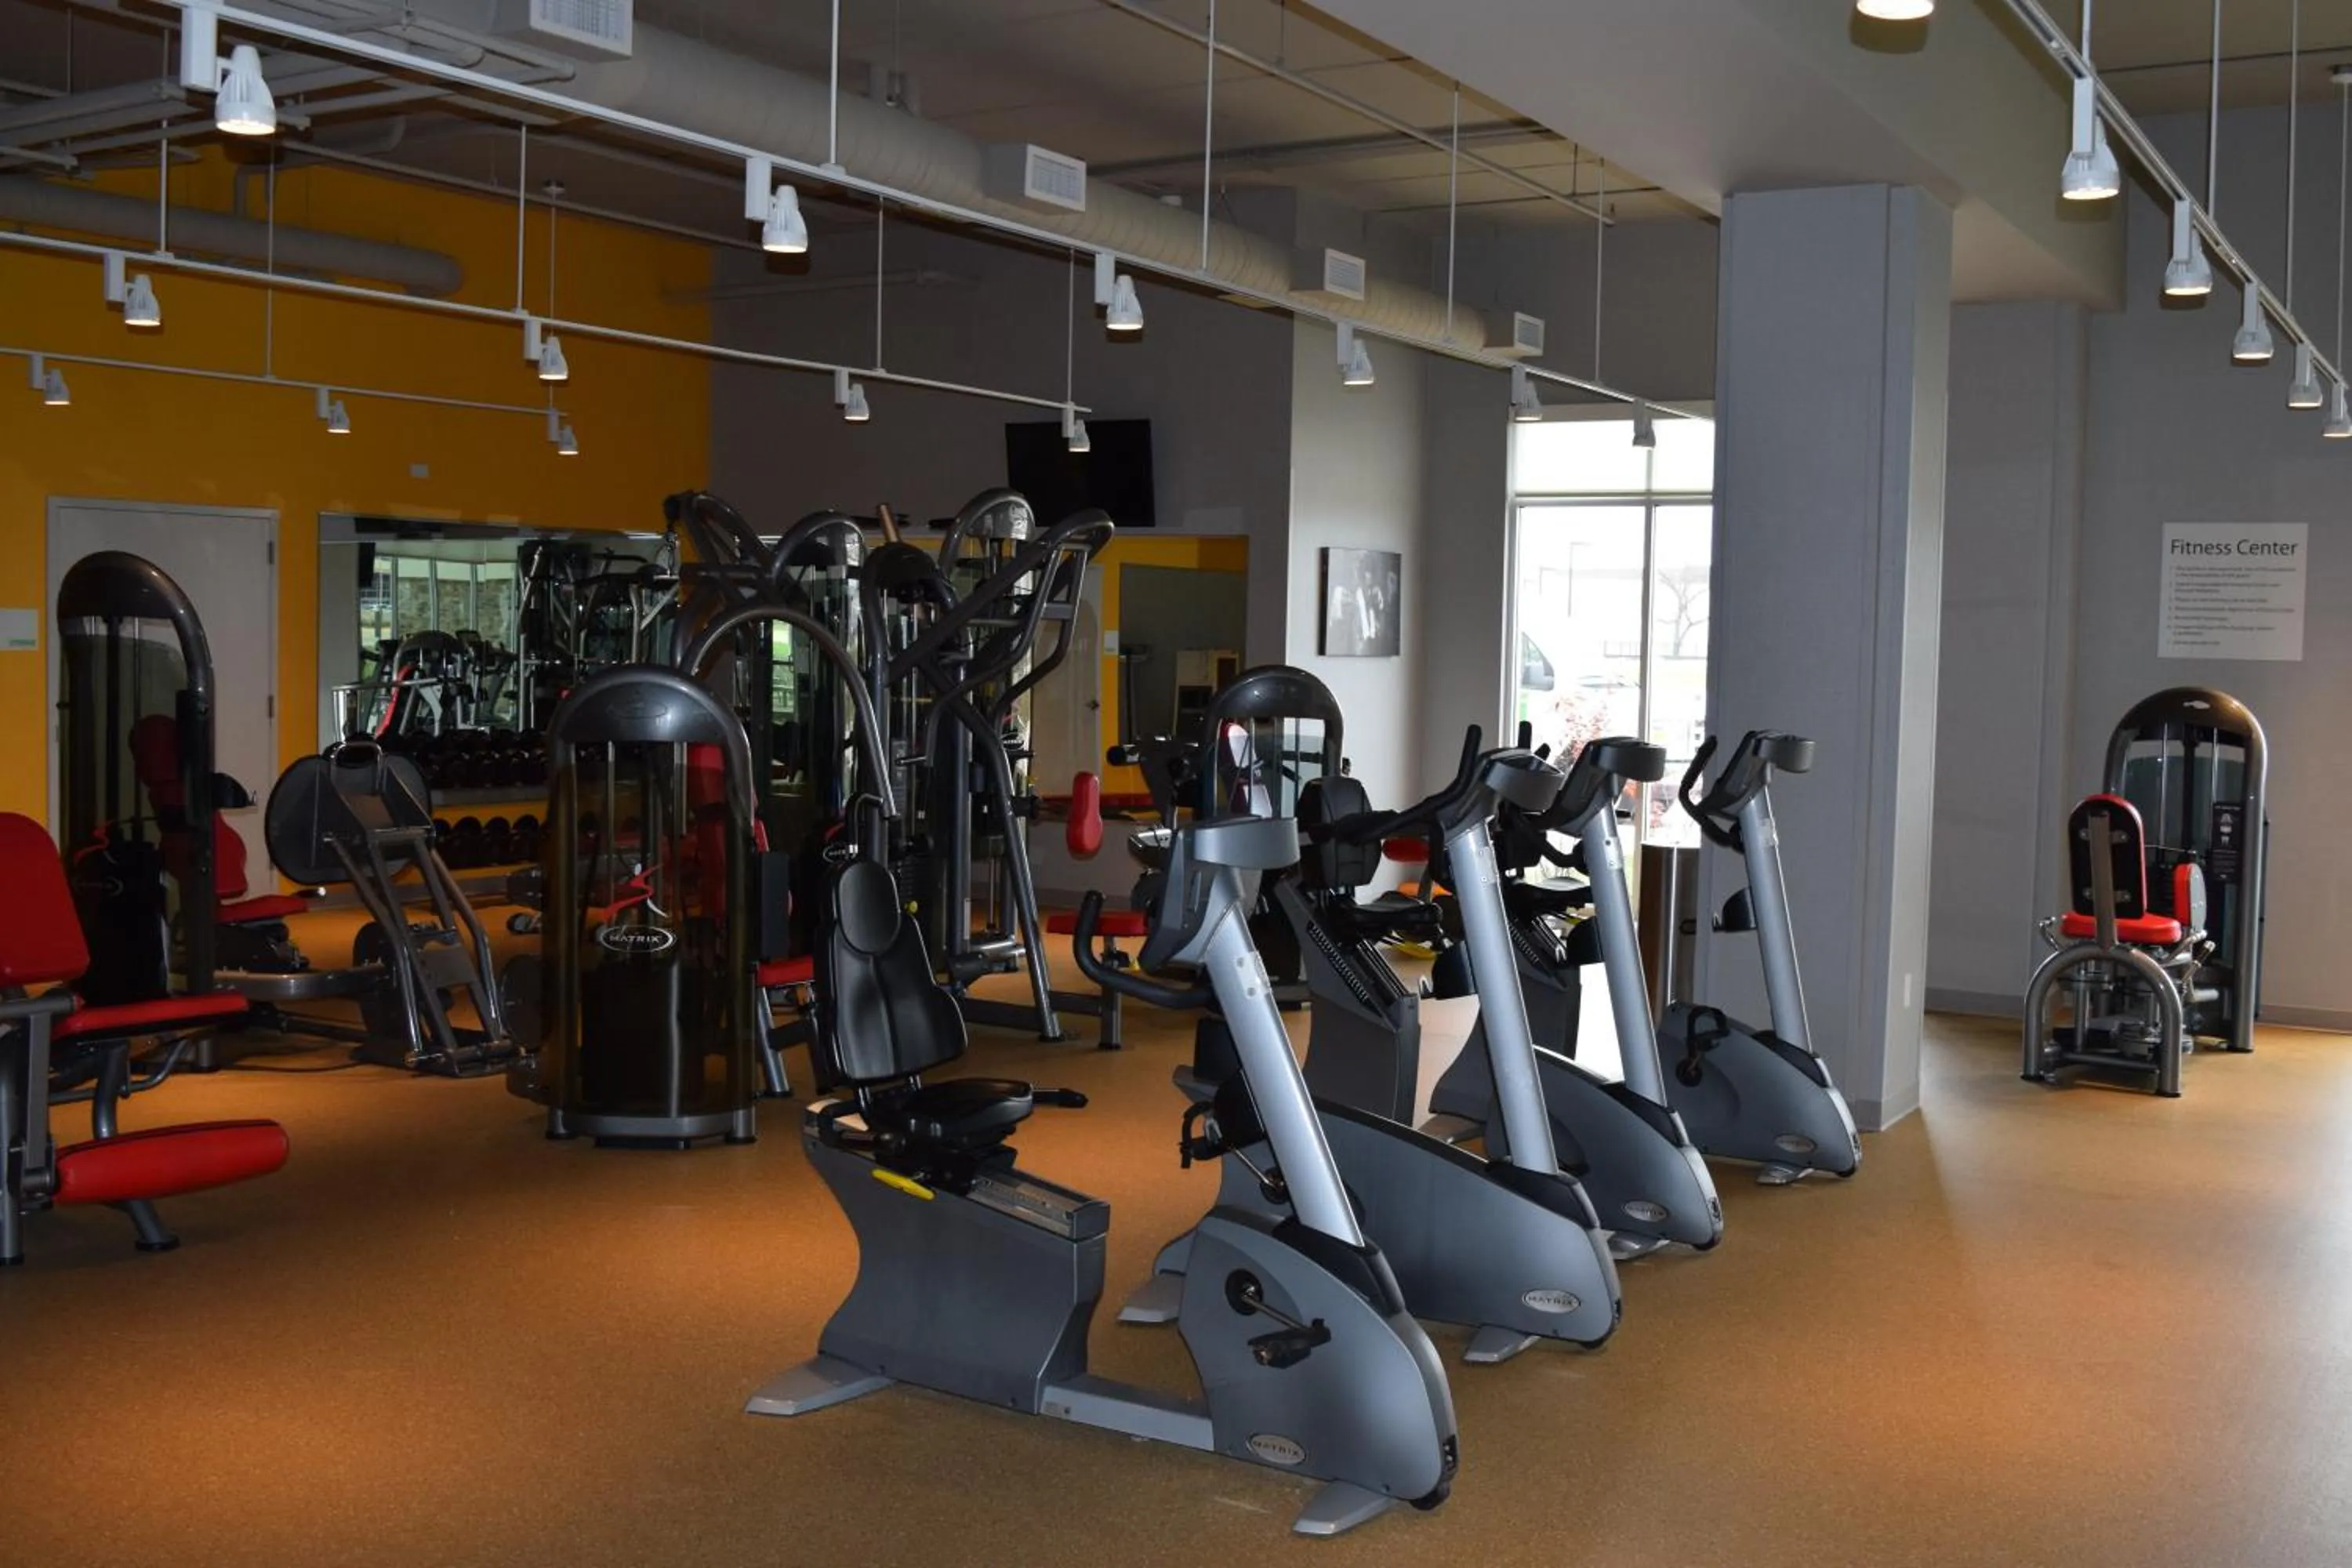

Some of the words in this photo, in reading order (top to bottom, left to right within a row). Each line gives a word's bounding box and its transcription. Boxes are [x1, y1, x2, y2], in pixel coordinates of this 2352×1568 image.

[2170, 539, 2232, 555] Fitness
[2237, 539, 2298, 556] Center
[1252, 1440, 1299, 1456] MATRIX
